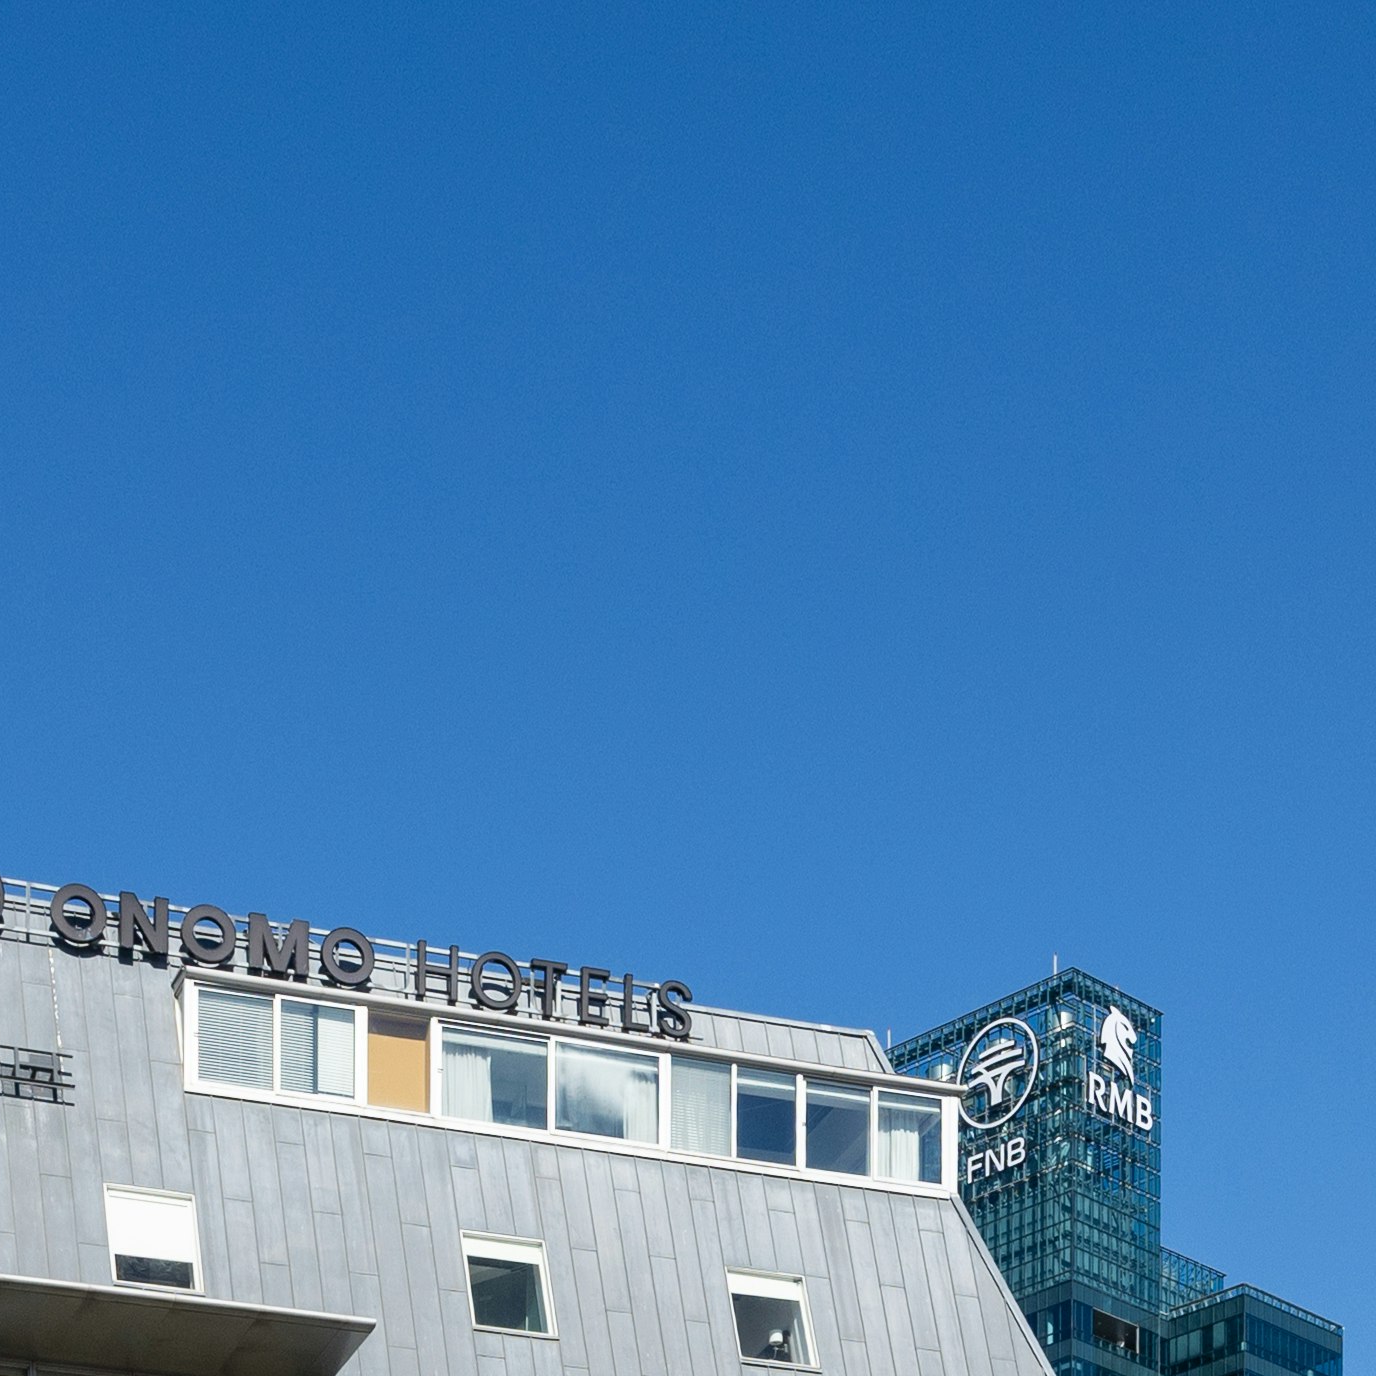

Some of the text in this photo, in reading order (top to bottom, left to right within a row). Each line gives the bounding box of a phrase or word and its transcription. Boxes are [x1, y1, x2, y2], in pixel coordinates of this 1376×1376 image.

[51, 883, 693, 1038] ONOMO HOTELS
[1087, 1071, 1154, 1132] RMB
[967, 1136, 1026, 1185] FNB
